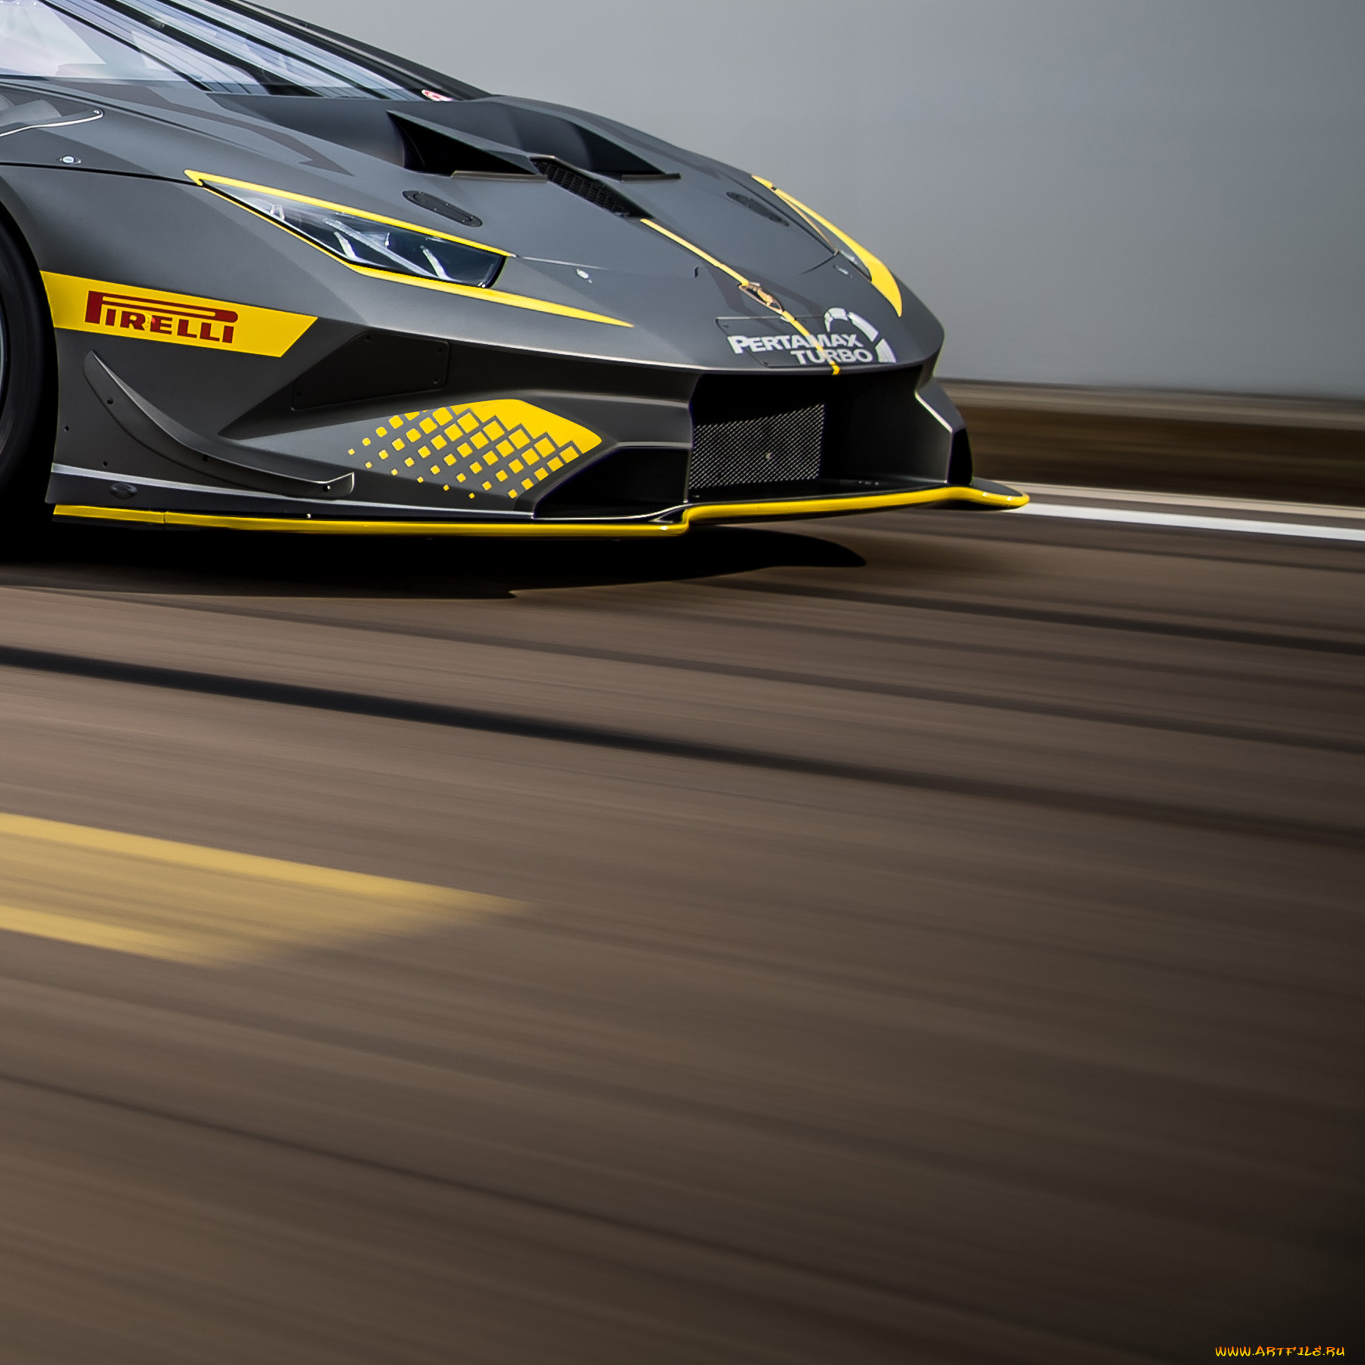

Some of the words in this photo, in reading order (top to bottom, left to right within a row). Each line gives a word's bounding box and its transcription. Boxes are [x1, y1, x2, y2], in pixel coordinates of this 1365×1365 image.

[85, 290, 239, 344] PIRELLI
[727, 334, 864, 354] PERTAMAX
[790, 350, 873, 365] TURBO
